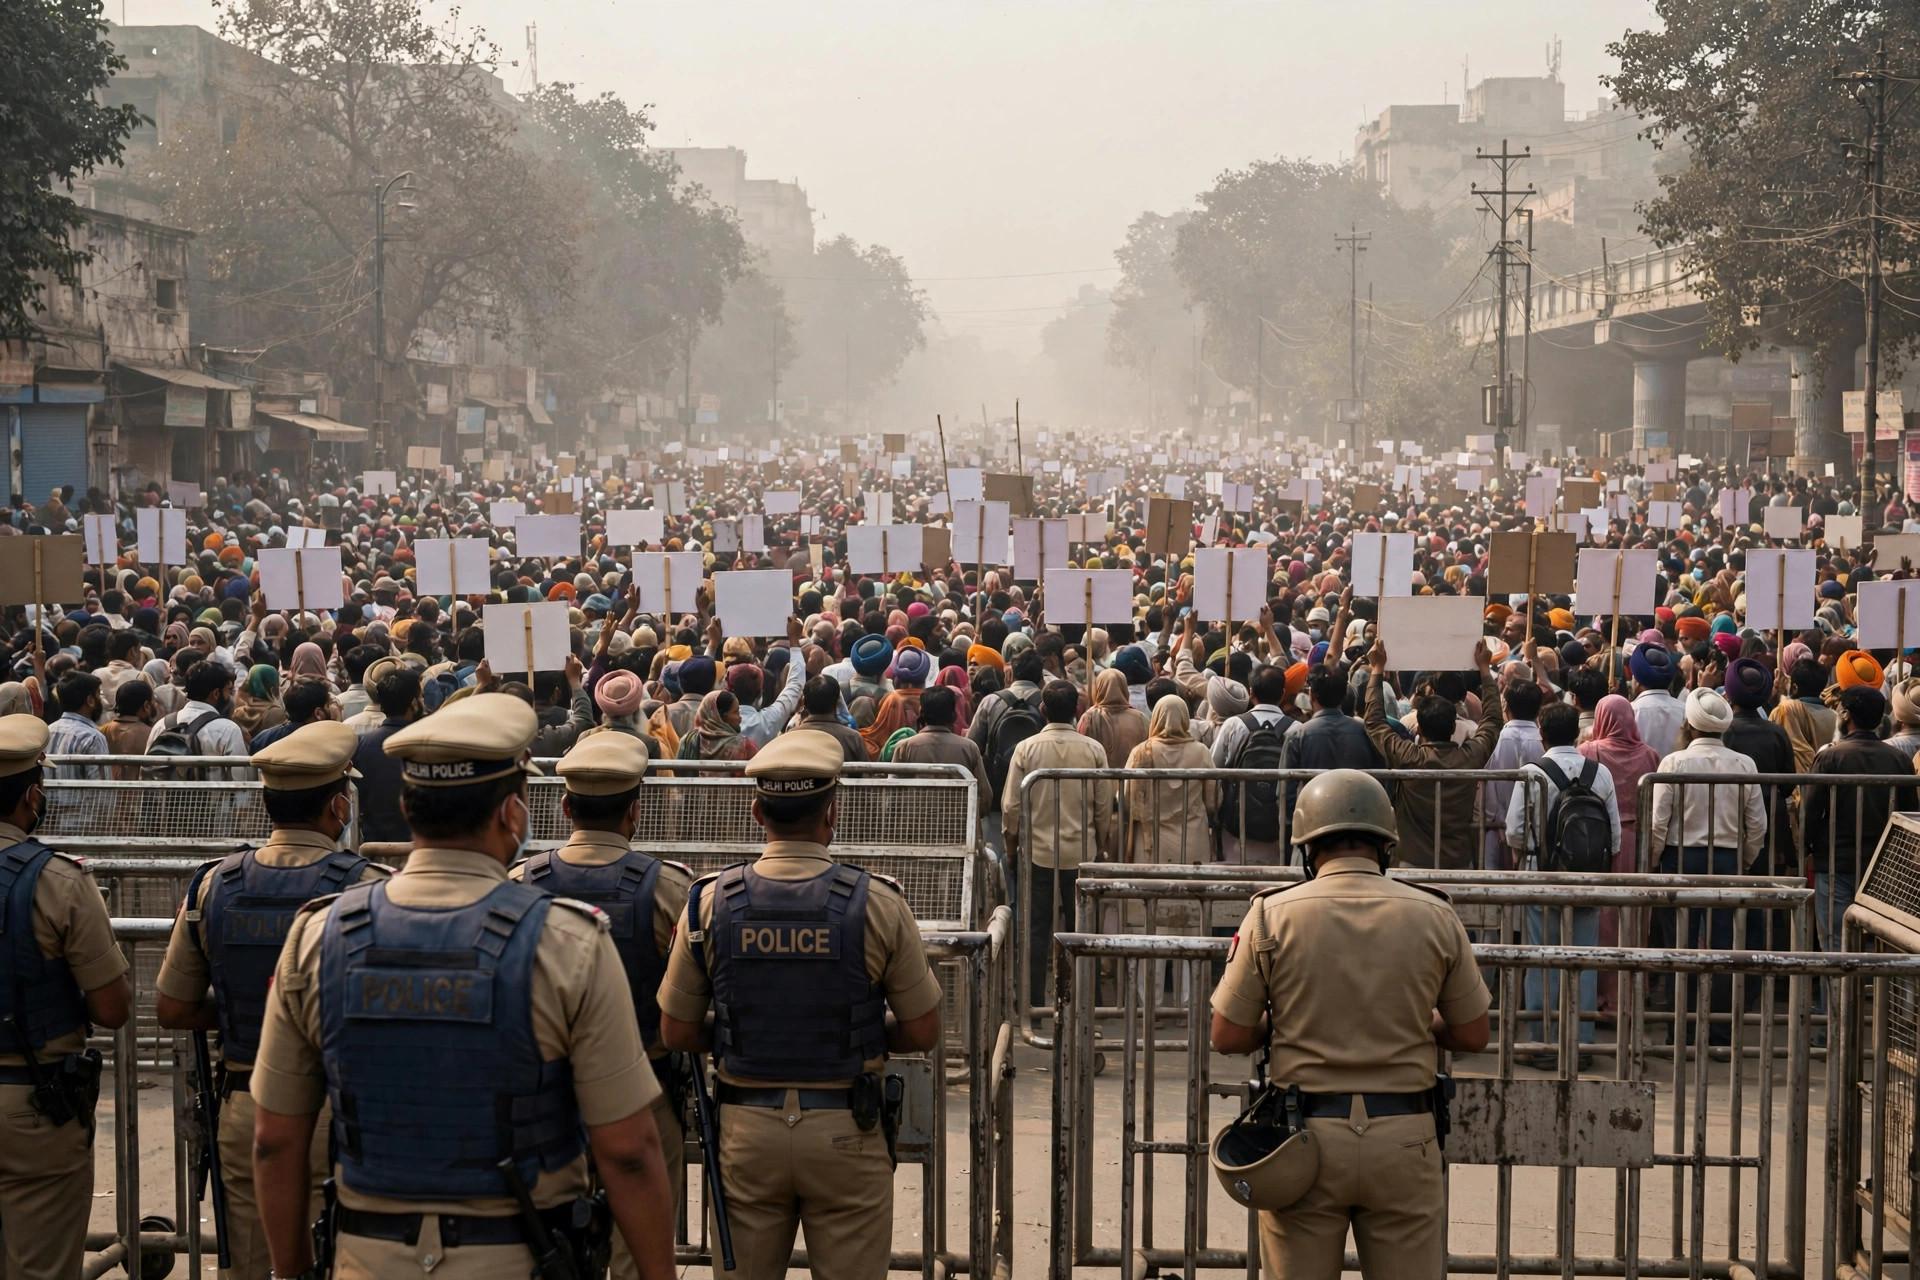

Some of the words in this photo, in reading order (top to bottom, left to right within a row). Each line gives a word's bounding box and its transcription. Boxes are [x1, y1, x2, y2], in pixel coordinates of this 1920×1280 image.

[432, 762, 475, 778] POLICE
[784, 779, 815, 792] POLICE
[231, 911, 294, 938] POLIC
[741, 927, 831, 953] POLICE
[362, 975, 474, 1014] POLICE
